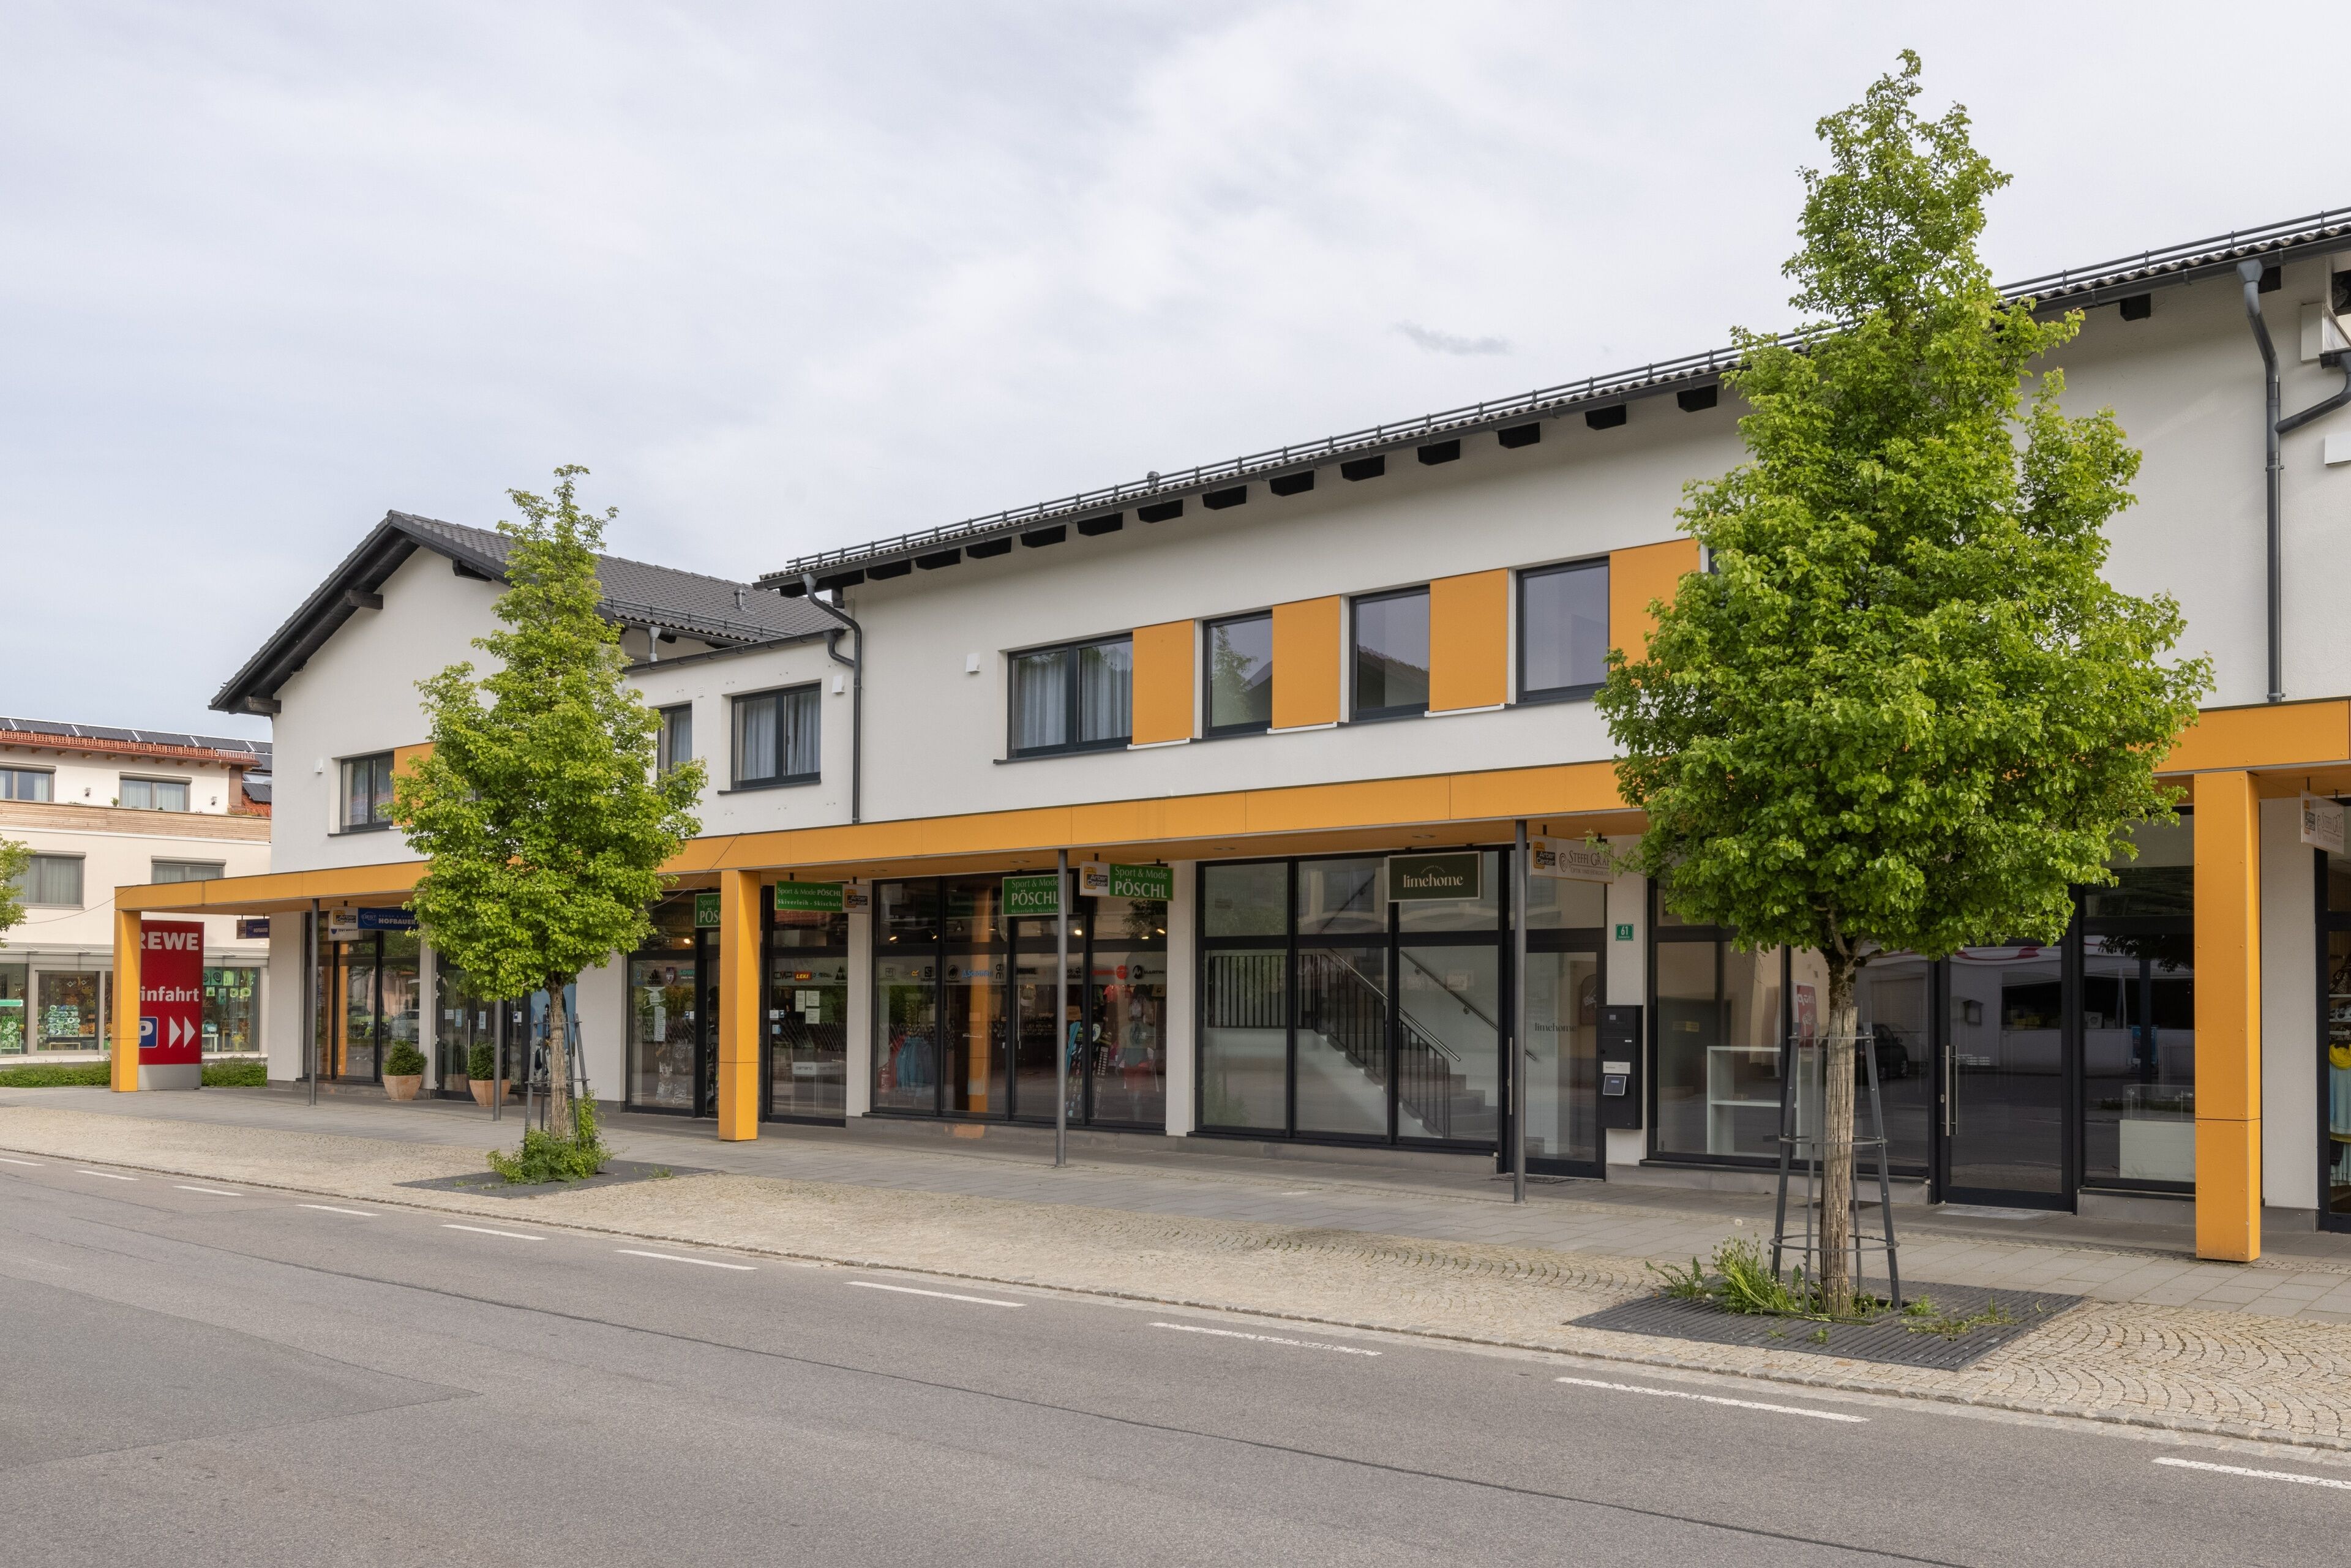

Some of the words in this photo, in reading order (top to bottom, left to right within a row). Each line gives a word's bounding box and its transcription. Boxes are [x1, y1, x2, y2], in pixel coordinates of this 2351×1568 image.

[1569, 850, 1589, 864] STEFFI
[1115, 866, 1136, 879] Sport
[1138, 869, 1144, 877] &
[1146, 869, 1168, 879] Mode
[1012, 880, 1029, 891] Sport
[1403, 873, 1464, 888] limehome
[817, 888, 842, 897] PÖSCHL
[1115, 879, 1167, 898] PÖSCHL
[700, 898, 715, 908] Sport
[1011, 890, 1059, 906] PÖSCHL
[700, 907, 721, 923] PÖS
[1621, 926, 1629, 936] 61
[141, 986, 199, 1002] infahrt
[1534, 1022, 1578, 1032] limehome
